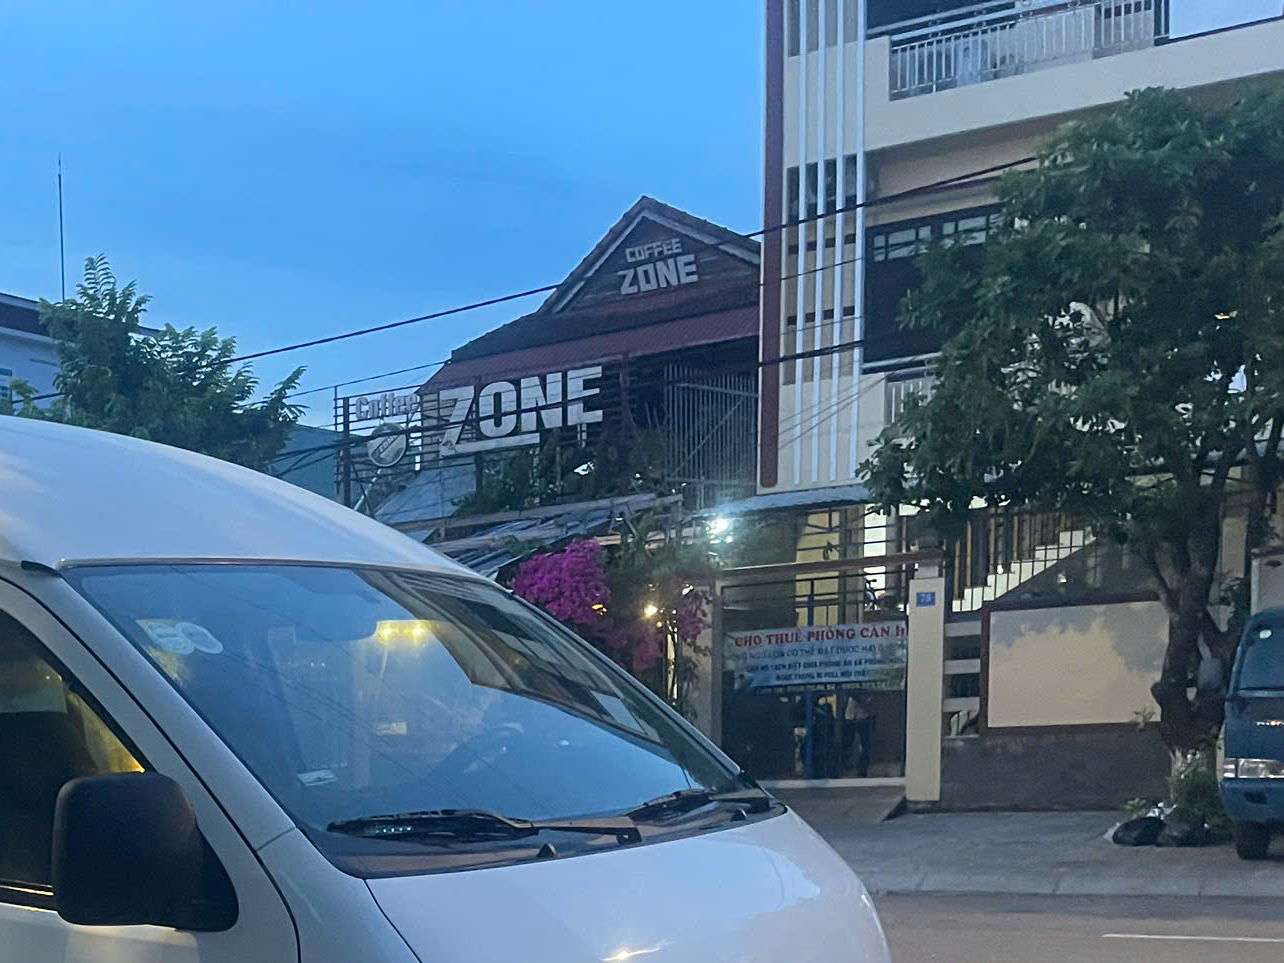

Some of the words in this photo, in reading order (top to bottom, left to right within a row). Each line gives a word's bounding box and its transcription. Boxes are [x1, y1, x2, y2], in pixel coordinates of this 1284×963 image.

[625, 238, 682, 263] COFFEE
[618, 254, 699, 295] ZONE
[439, 365, 604, 457] ZONE
[735, 635, 762, 647] CHO
